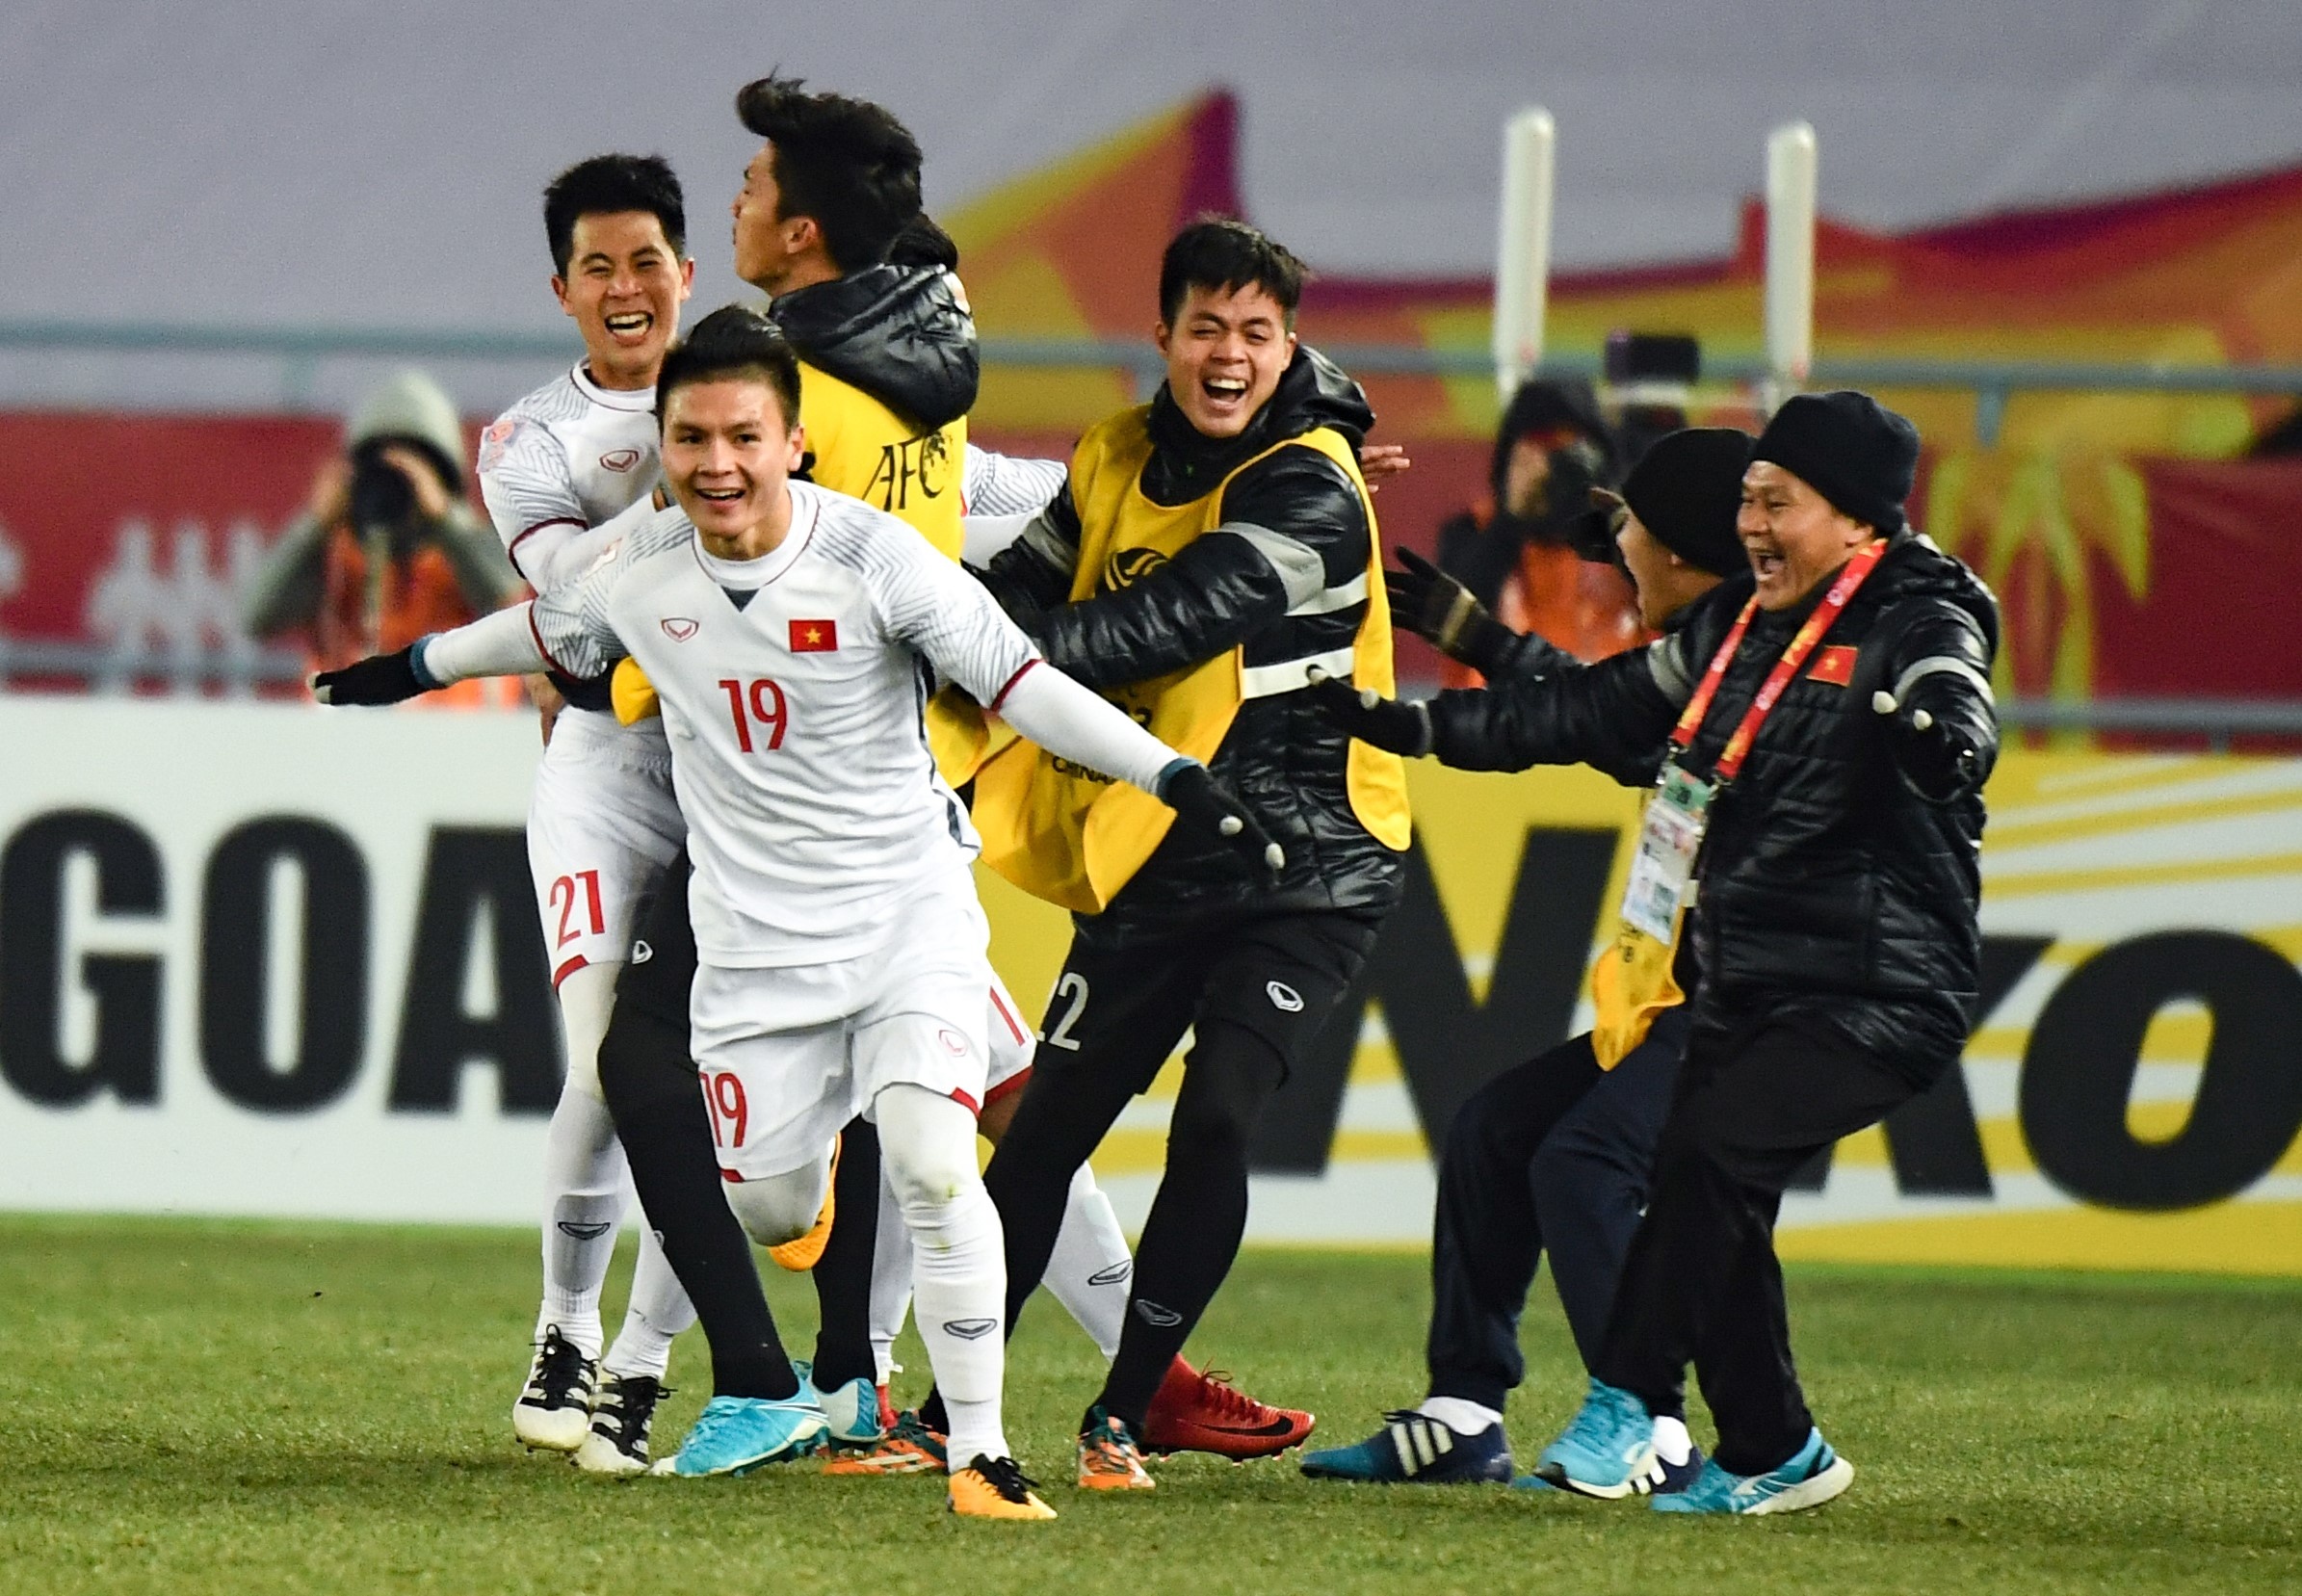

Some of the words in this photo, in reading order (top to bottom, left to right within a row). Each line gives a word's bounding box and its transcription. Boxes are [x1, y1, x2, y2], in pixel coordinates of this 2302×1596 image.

[861, 432, 952, 511] AFC
[719, 679, 787, 752] 19
[549, 870, 605, 950] 21
[0, 806, 568, 1118] GOA
[1037, 972, 1089, 1051] 2
[698, 1071, 747, 1148] 19
